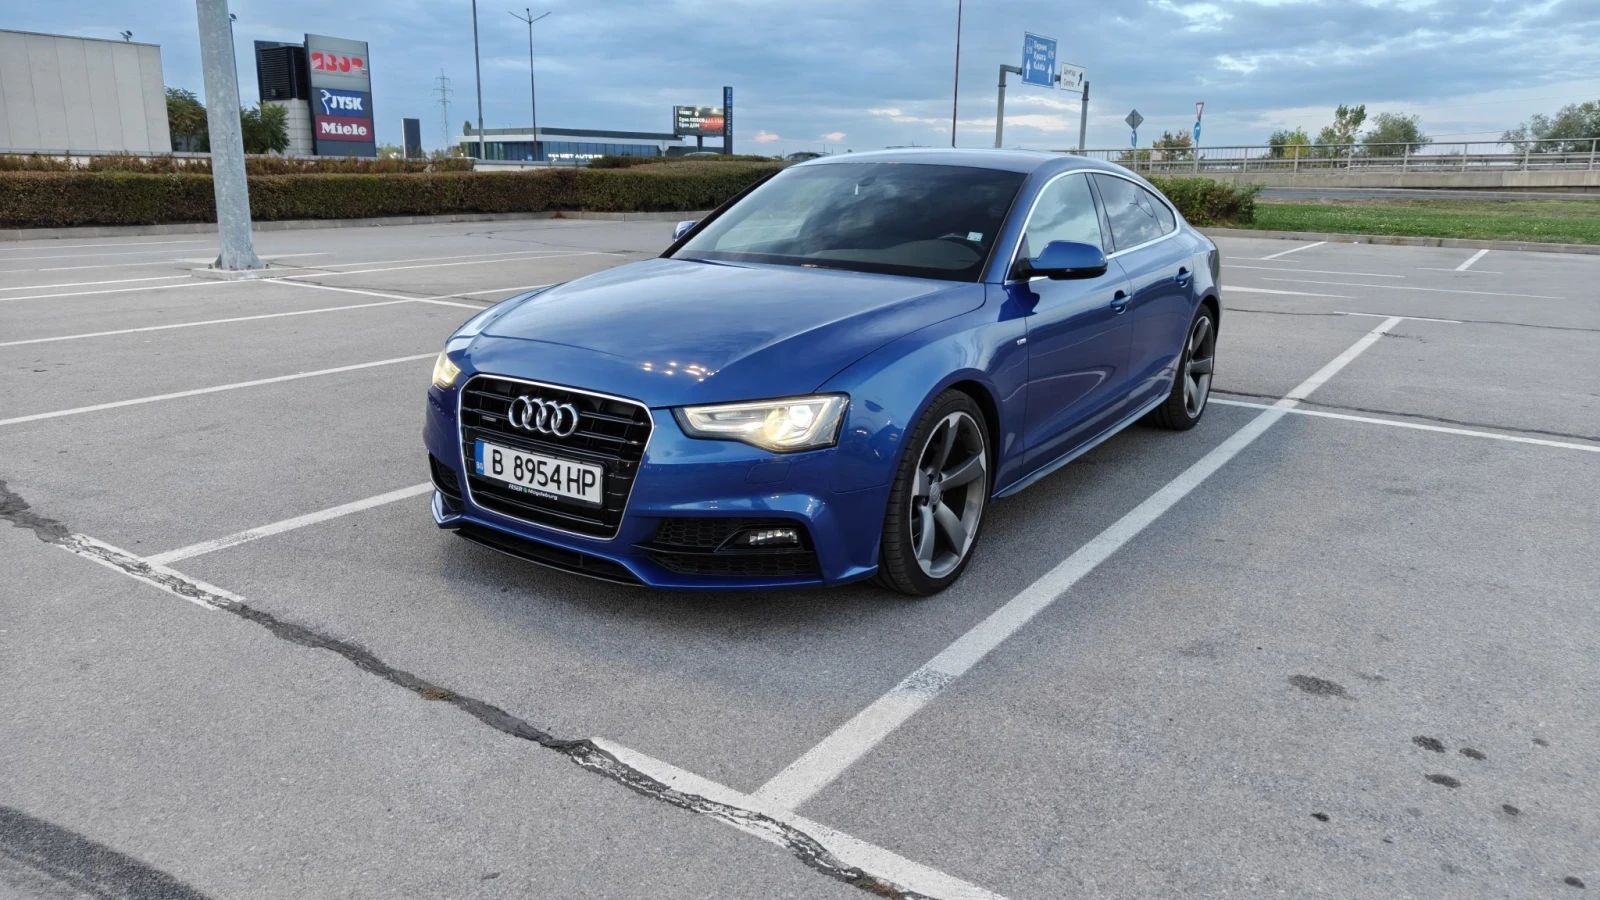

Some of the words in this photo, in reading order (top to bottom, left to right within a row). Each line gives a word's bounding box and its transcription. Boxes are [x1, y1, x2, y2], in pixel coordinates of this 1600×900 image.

[330, 95, 363, 111] JYSK
[321, 121, 367, 136] Miele
[492, 449, 503, 475] B
[513, 455, 562, 491] 8954
[566, 466, 596, 496] HP
[528, 488, 558, 500] Magdeburg
